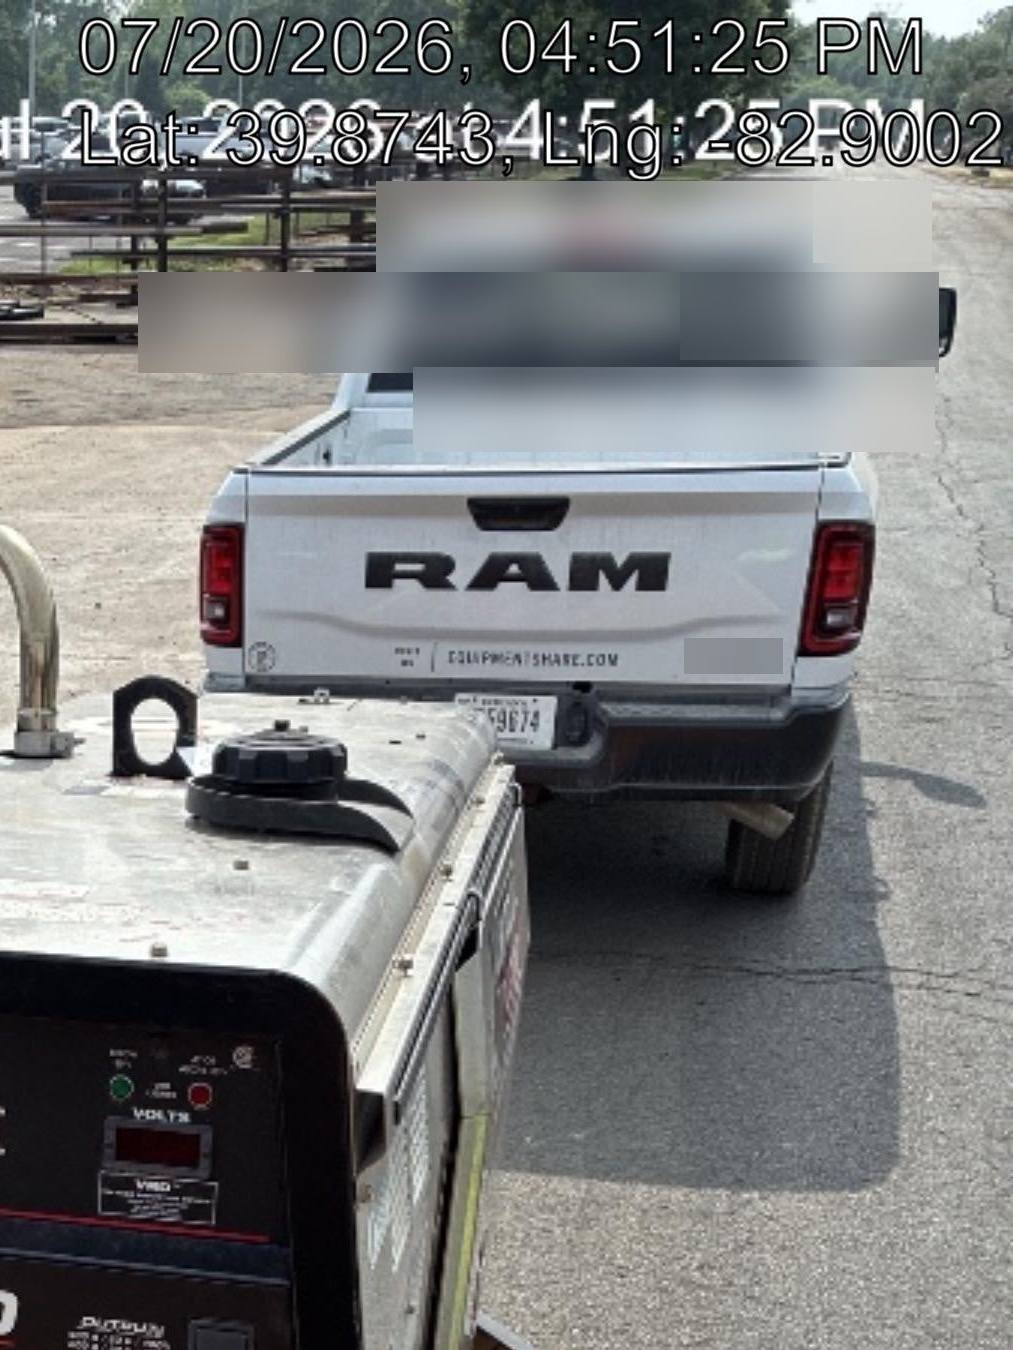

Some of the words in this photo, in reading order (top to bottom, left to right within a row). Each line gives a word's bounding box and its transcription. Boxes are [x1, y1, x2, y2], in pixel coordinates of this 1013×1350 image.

[364, 551, 672, 592] RAM
[447, 650, 620, 668] EQUIPMENTSHARE.COM
[132, 1106, 192, 1123] VOLTS
